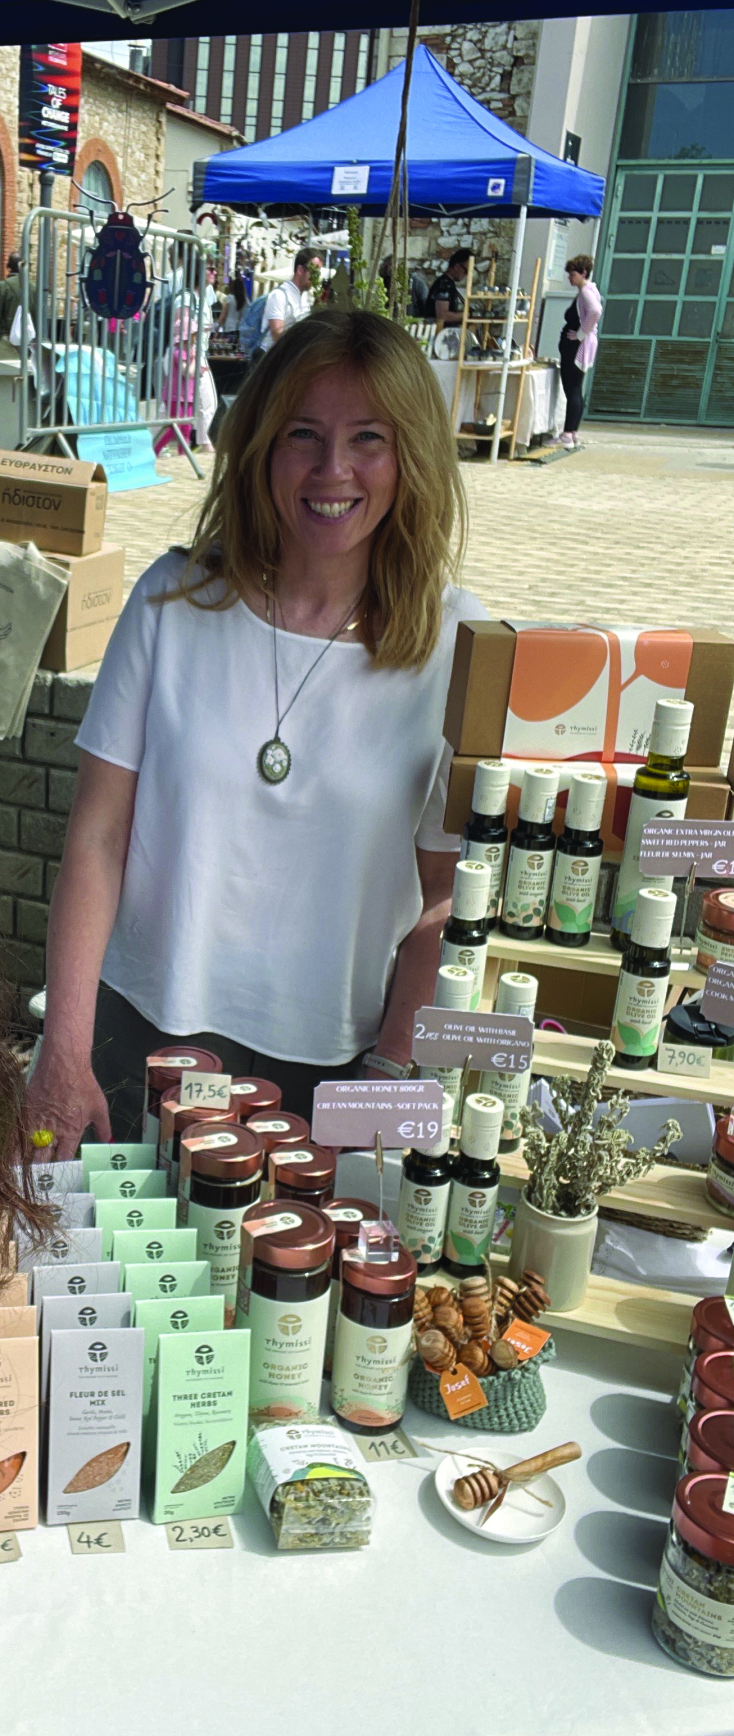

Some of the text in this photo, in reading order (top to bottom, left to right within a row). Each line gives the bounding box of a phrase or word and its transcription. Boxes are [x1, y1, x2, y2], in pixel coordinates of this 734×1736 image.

[51, 97, 63, 109] OF
[1, 458, 73, 475] ΕΥΘΡΑΥΣΤΟΝ
[700, 829, 722, 837] VIRGIN
[665, 839, 680, 847] RED
[680, 840, 709, 848] PEPPERS
[714, 840, 727, 849] JAR
[700, 852, 713, 860] JAR
[626, 1005, 658, 1014] ORGANIC
[415, 1023, 439, 1041] 2 PCS
[443, 1023, 518, 1037] OLIVE OIL WITH BASIL
[442, 1033, 461, 1042] OLIVE
[463, 1035, 474, 1043] OIL
[476, 1036, 496, 1045] WITH
[491, 1052, 529, 1069] €15
[665, 1048, 706, 1067] 7,90€
[184, 1082, 229, 1101] 17,5€
[336, 1084, 370, 1093] ORGANIC
[371, 1084, 398, 1093] HONEY
[399, 1084, 425, 1093] 800GR
[316, 1102, 347, 1110] CRETAN
[347, 1102, 393, 1110] MOUNTAINS
[417, 1102, 439, 1110] PACK
[397, 1121, 439, 1139] €19
[265, 1337, 312, 1349] Thymissi
[355, 1355, 397, 1365] Thymissi
[79, 1364, 119, 1375] Thymissi
[186, 1366, 225, 1377] Thymissi
[263, 1362, 308, 1371] ORGANIC
[268, 1372, 302, 1380] HONEY
[353, 1373, 394, 1383] ORGANIC
[358, 1382, 388, 1391] HONEY
[443, 1373, 470, 1395] Josef
[70, 1390, 95, 1398] FLEUR
[111, 1389, 126, 1397] SEL
[200, 1390, 233, 1399] CRETAN
[190, 1400, 217, 1408] HERBS
[368, 1440, 405, 1458] 11€
[172, 1525, 228, 1543] 2,30€
[77, 1532, 112, 1548] 4€
